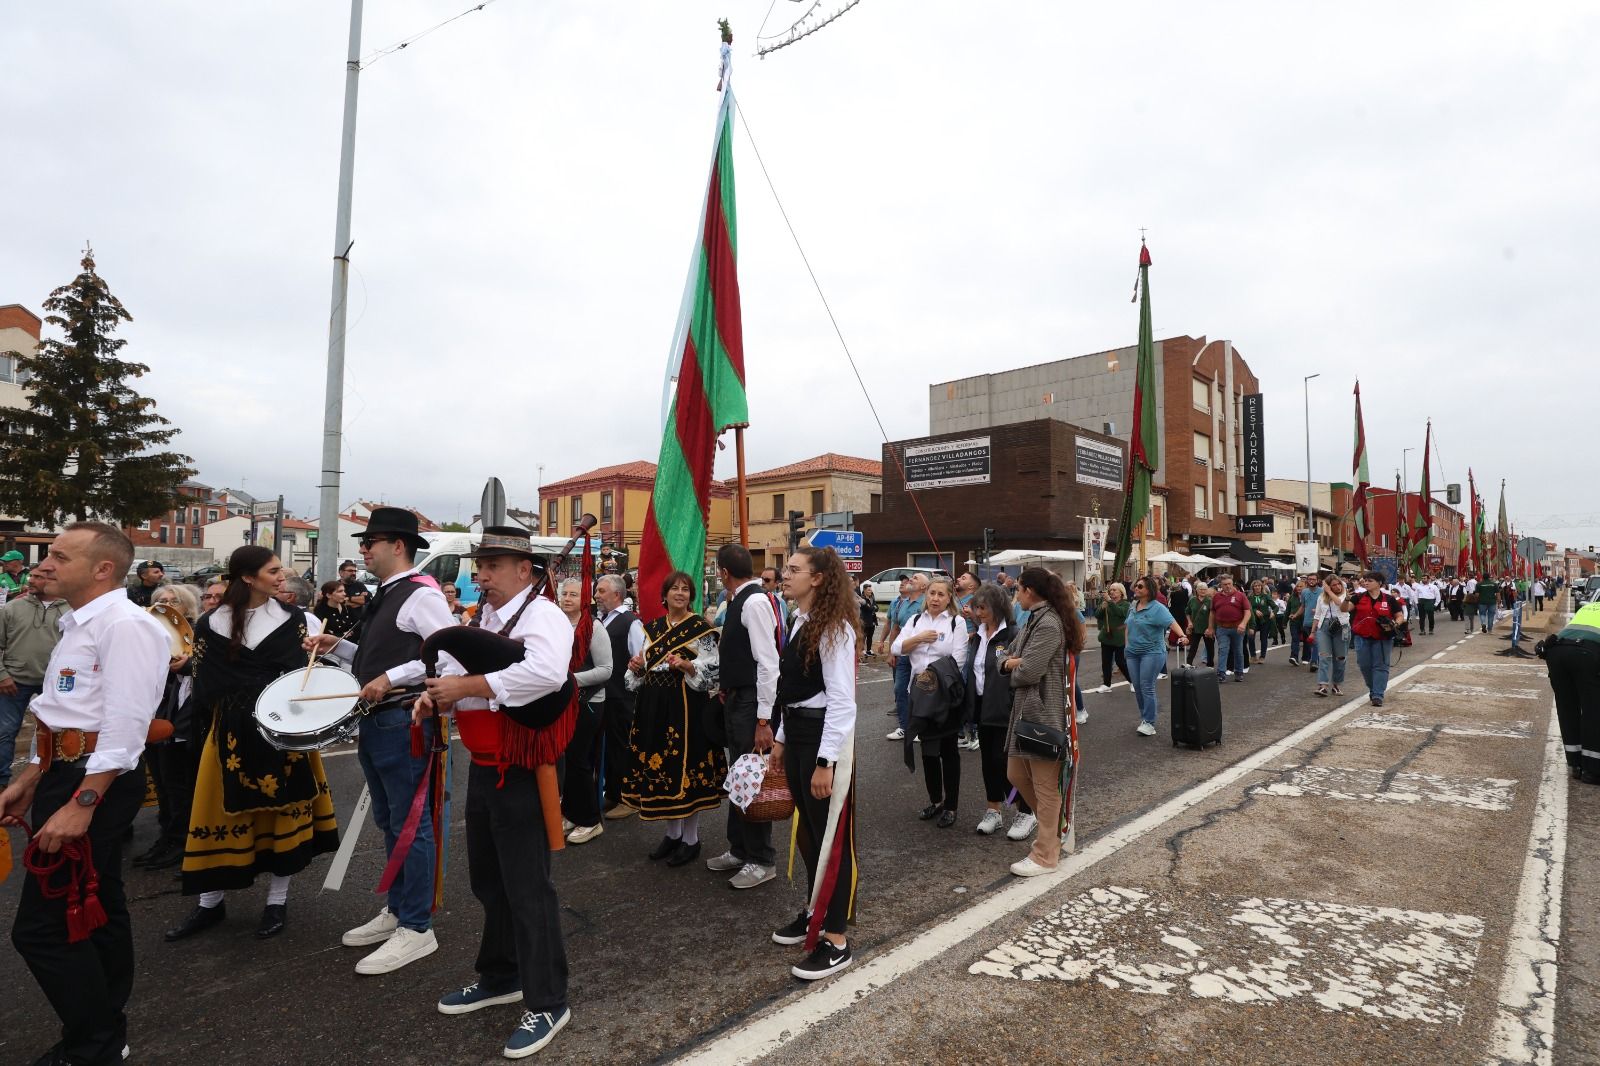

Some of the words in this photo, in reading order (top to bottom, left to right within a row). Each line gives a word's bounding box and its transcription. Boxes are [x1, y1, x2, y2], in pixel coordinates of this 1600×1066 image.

[1249, 397, 1258, 490] RESTAURANTE
[942, 450, 986, 460] VILLADANGOS
[834, 546, 853, 554] viedo
[845, 562, 861, 570] N-120
